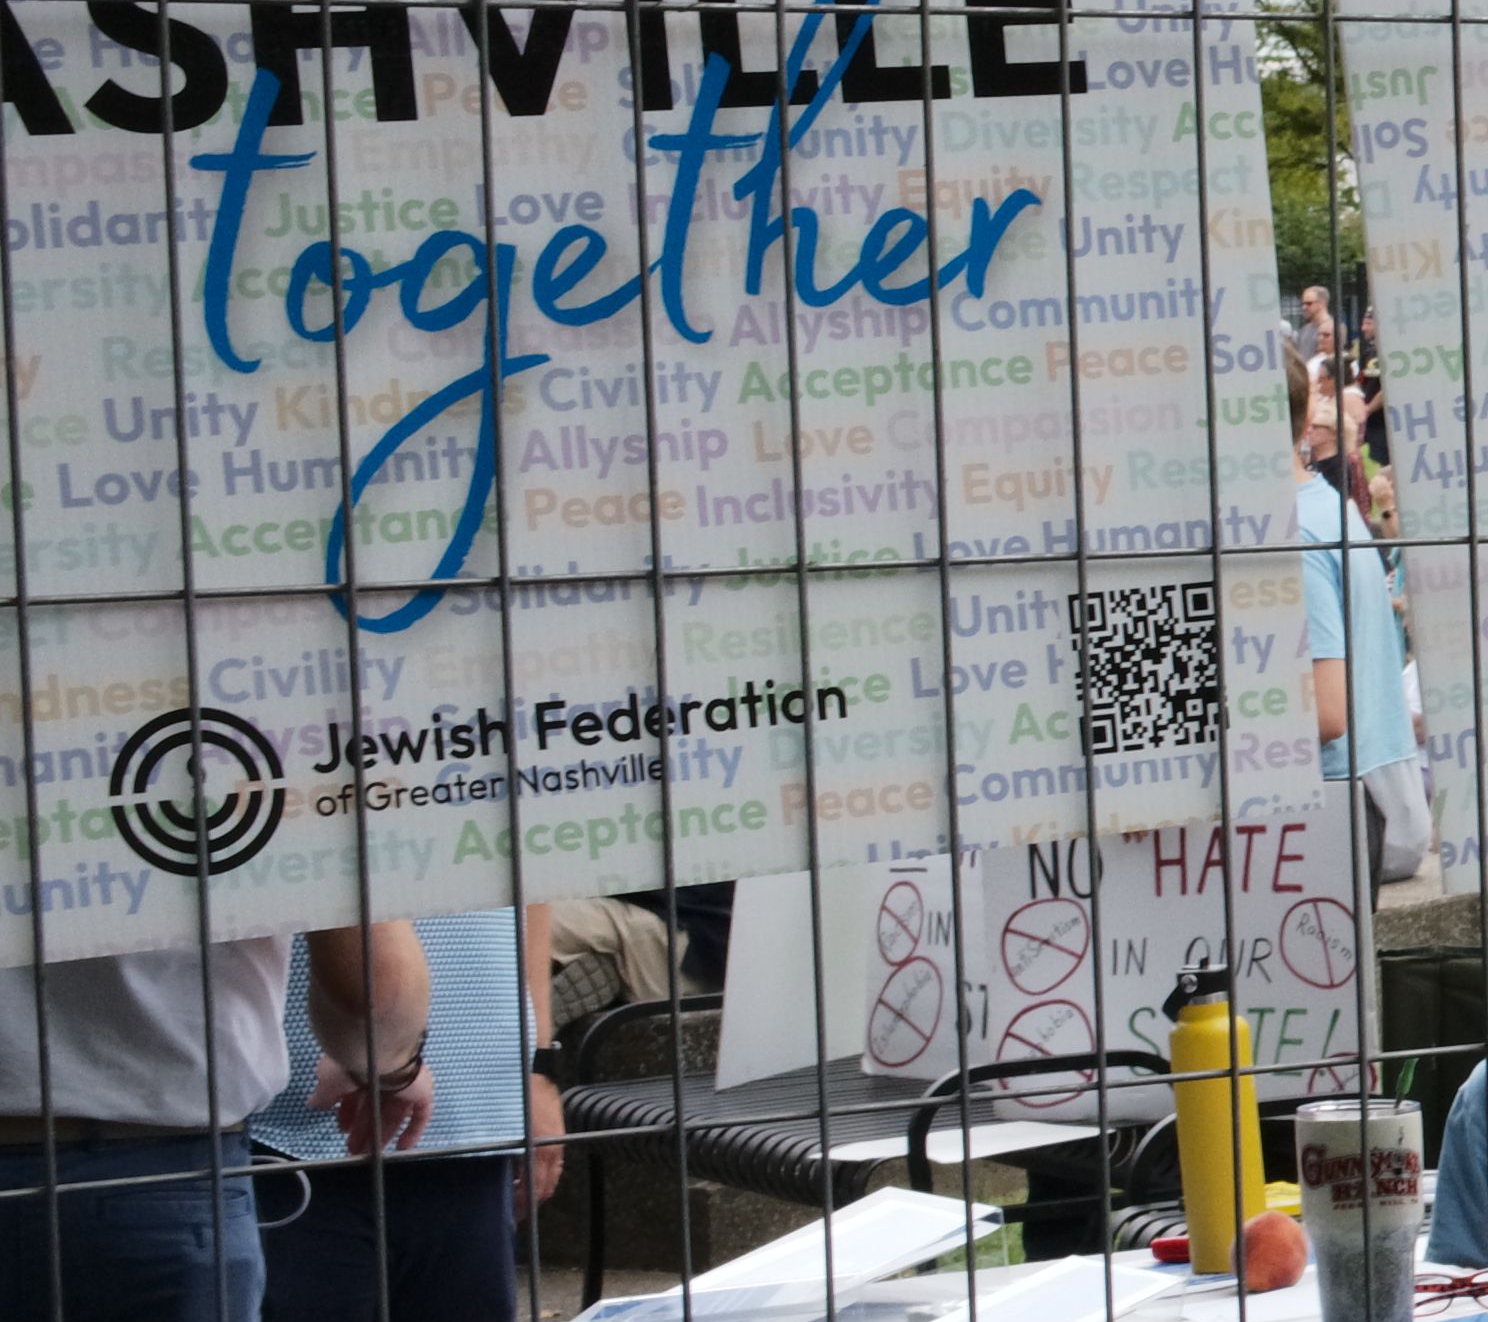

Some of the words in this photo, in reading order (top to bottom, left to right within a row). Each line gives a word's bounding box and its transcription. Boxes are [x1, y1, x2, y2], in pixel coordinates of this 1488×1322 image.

[729, 297, 928, 353] Allyship
[951, 276, 1224, 332] Community
[738, 349, 1034, 405] Acceptance
[1045, 339, 1189, 381] Peace
[314, 708, 512, 774] Jewish
[535, 679, 850, 752] Federation
[317, 782, 356, 818] of
[364, 771, 502, 812] Greater
[516, 750, 664, 794] Nashville
[1112, 938, 1148, 976] IN
[1128, 1007, 1341, 1077] STE!
